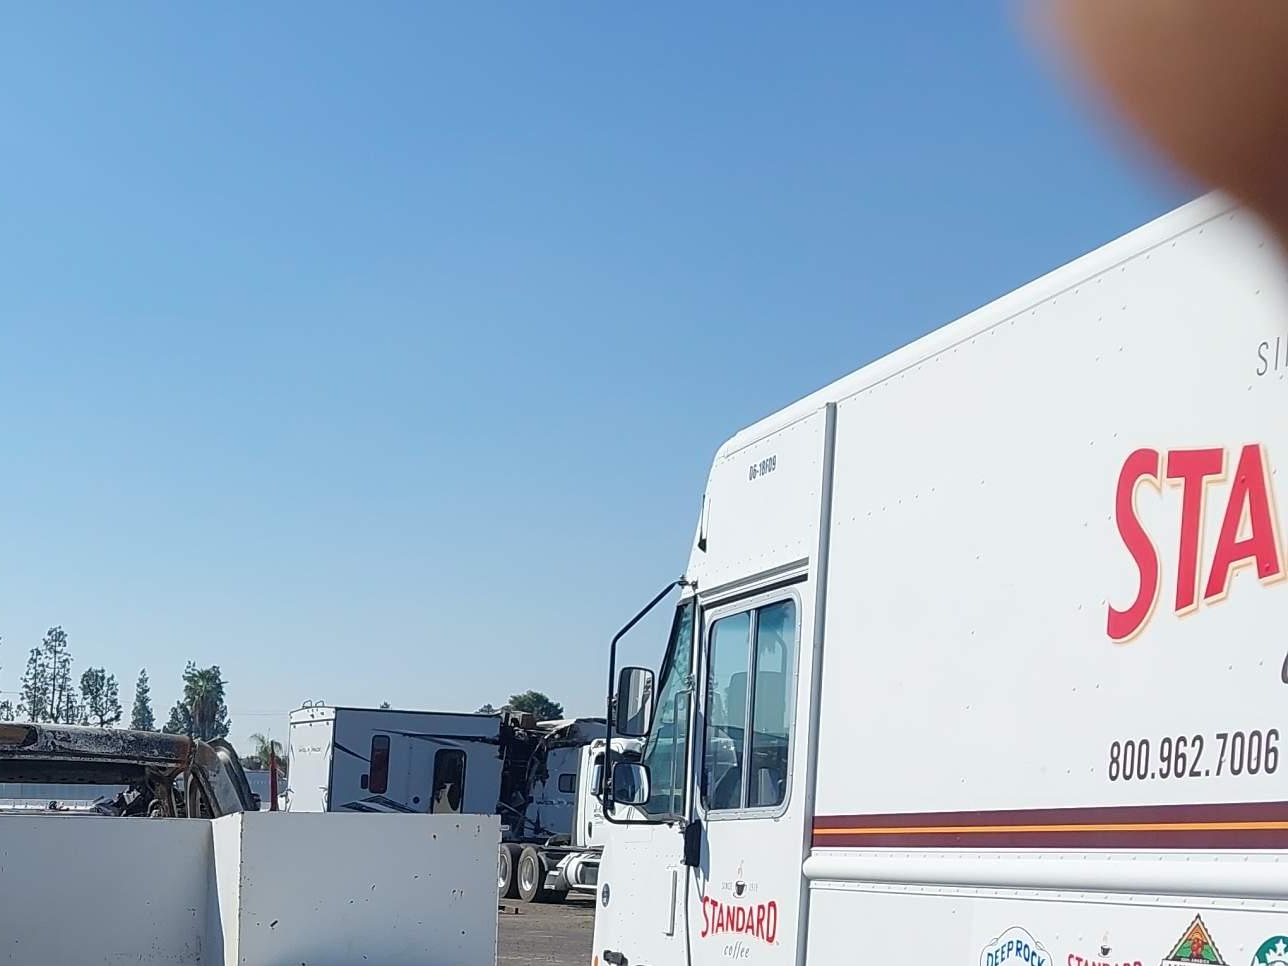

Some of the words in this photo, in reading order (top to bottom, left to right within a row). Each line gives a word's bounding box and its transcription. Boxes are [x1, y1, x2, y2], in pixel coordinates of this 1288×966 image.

[1256, 336, 1288, 376] SI
[1108, 728, 1280, 782] 800.962.7006
[701, 895, 777, 944] STANDARD
[723, 941, 750, 960] coffee
